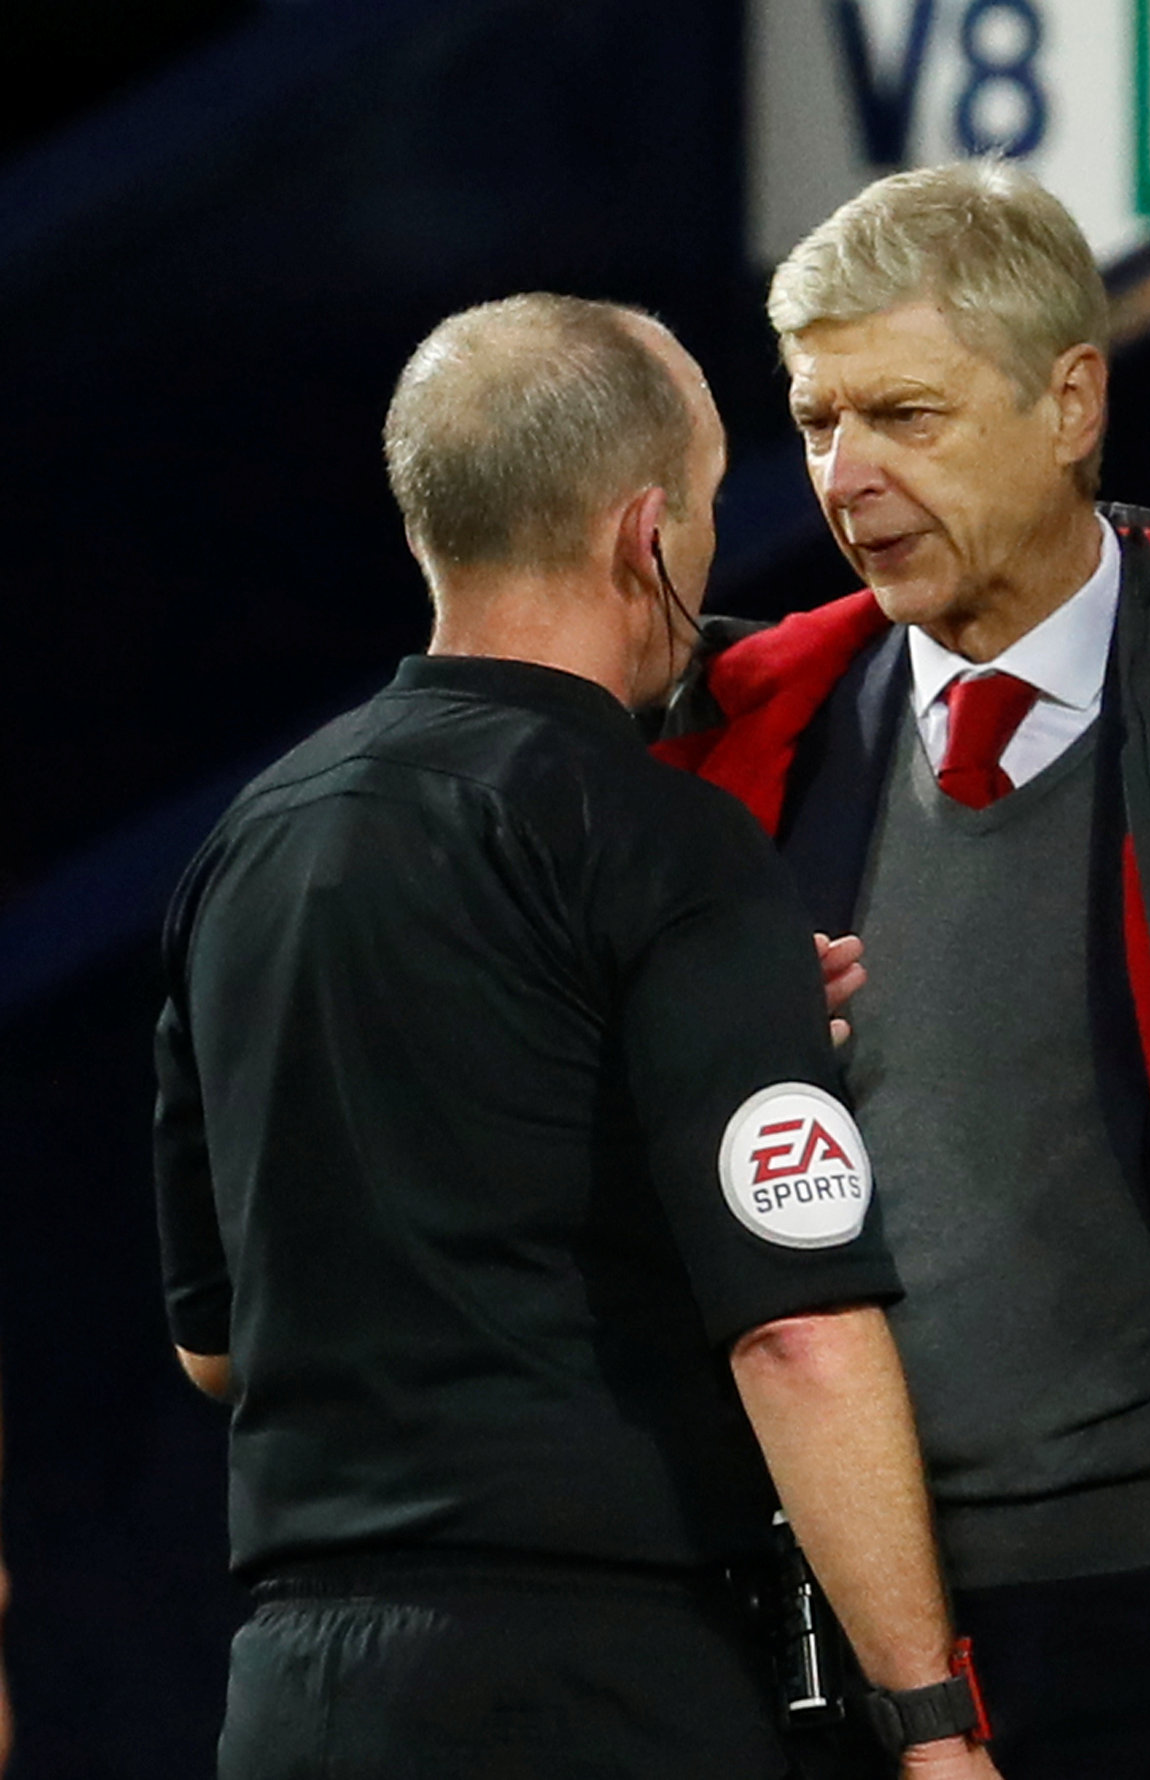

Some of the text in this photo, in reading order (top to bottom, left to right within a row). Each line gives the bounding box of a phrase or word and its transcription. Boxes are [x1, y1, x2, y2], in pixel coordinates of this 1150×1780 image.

[832, 0, 1047, 165] V8
[750, 1118, 855, 1184] EA
[753, 1174, 862, 1213] SPORTS
